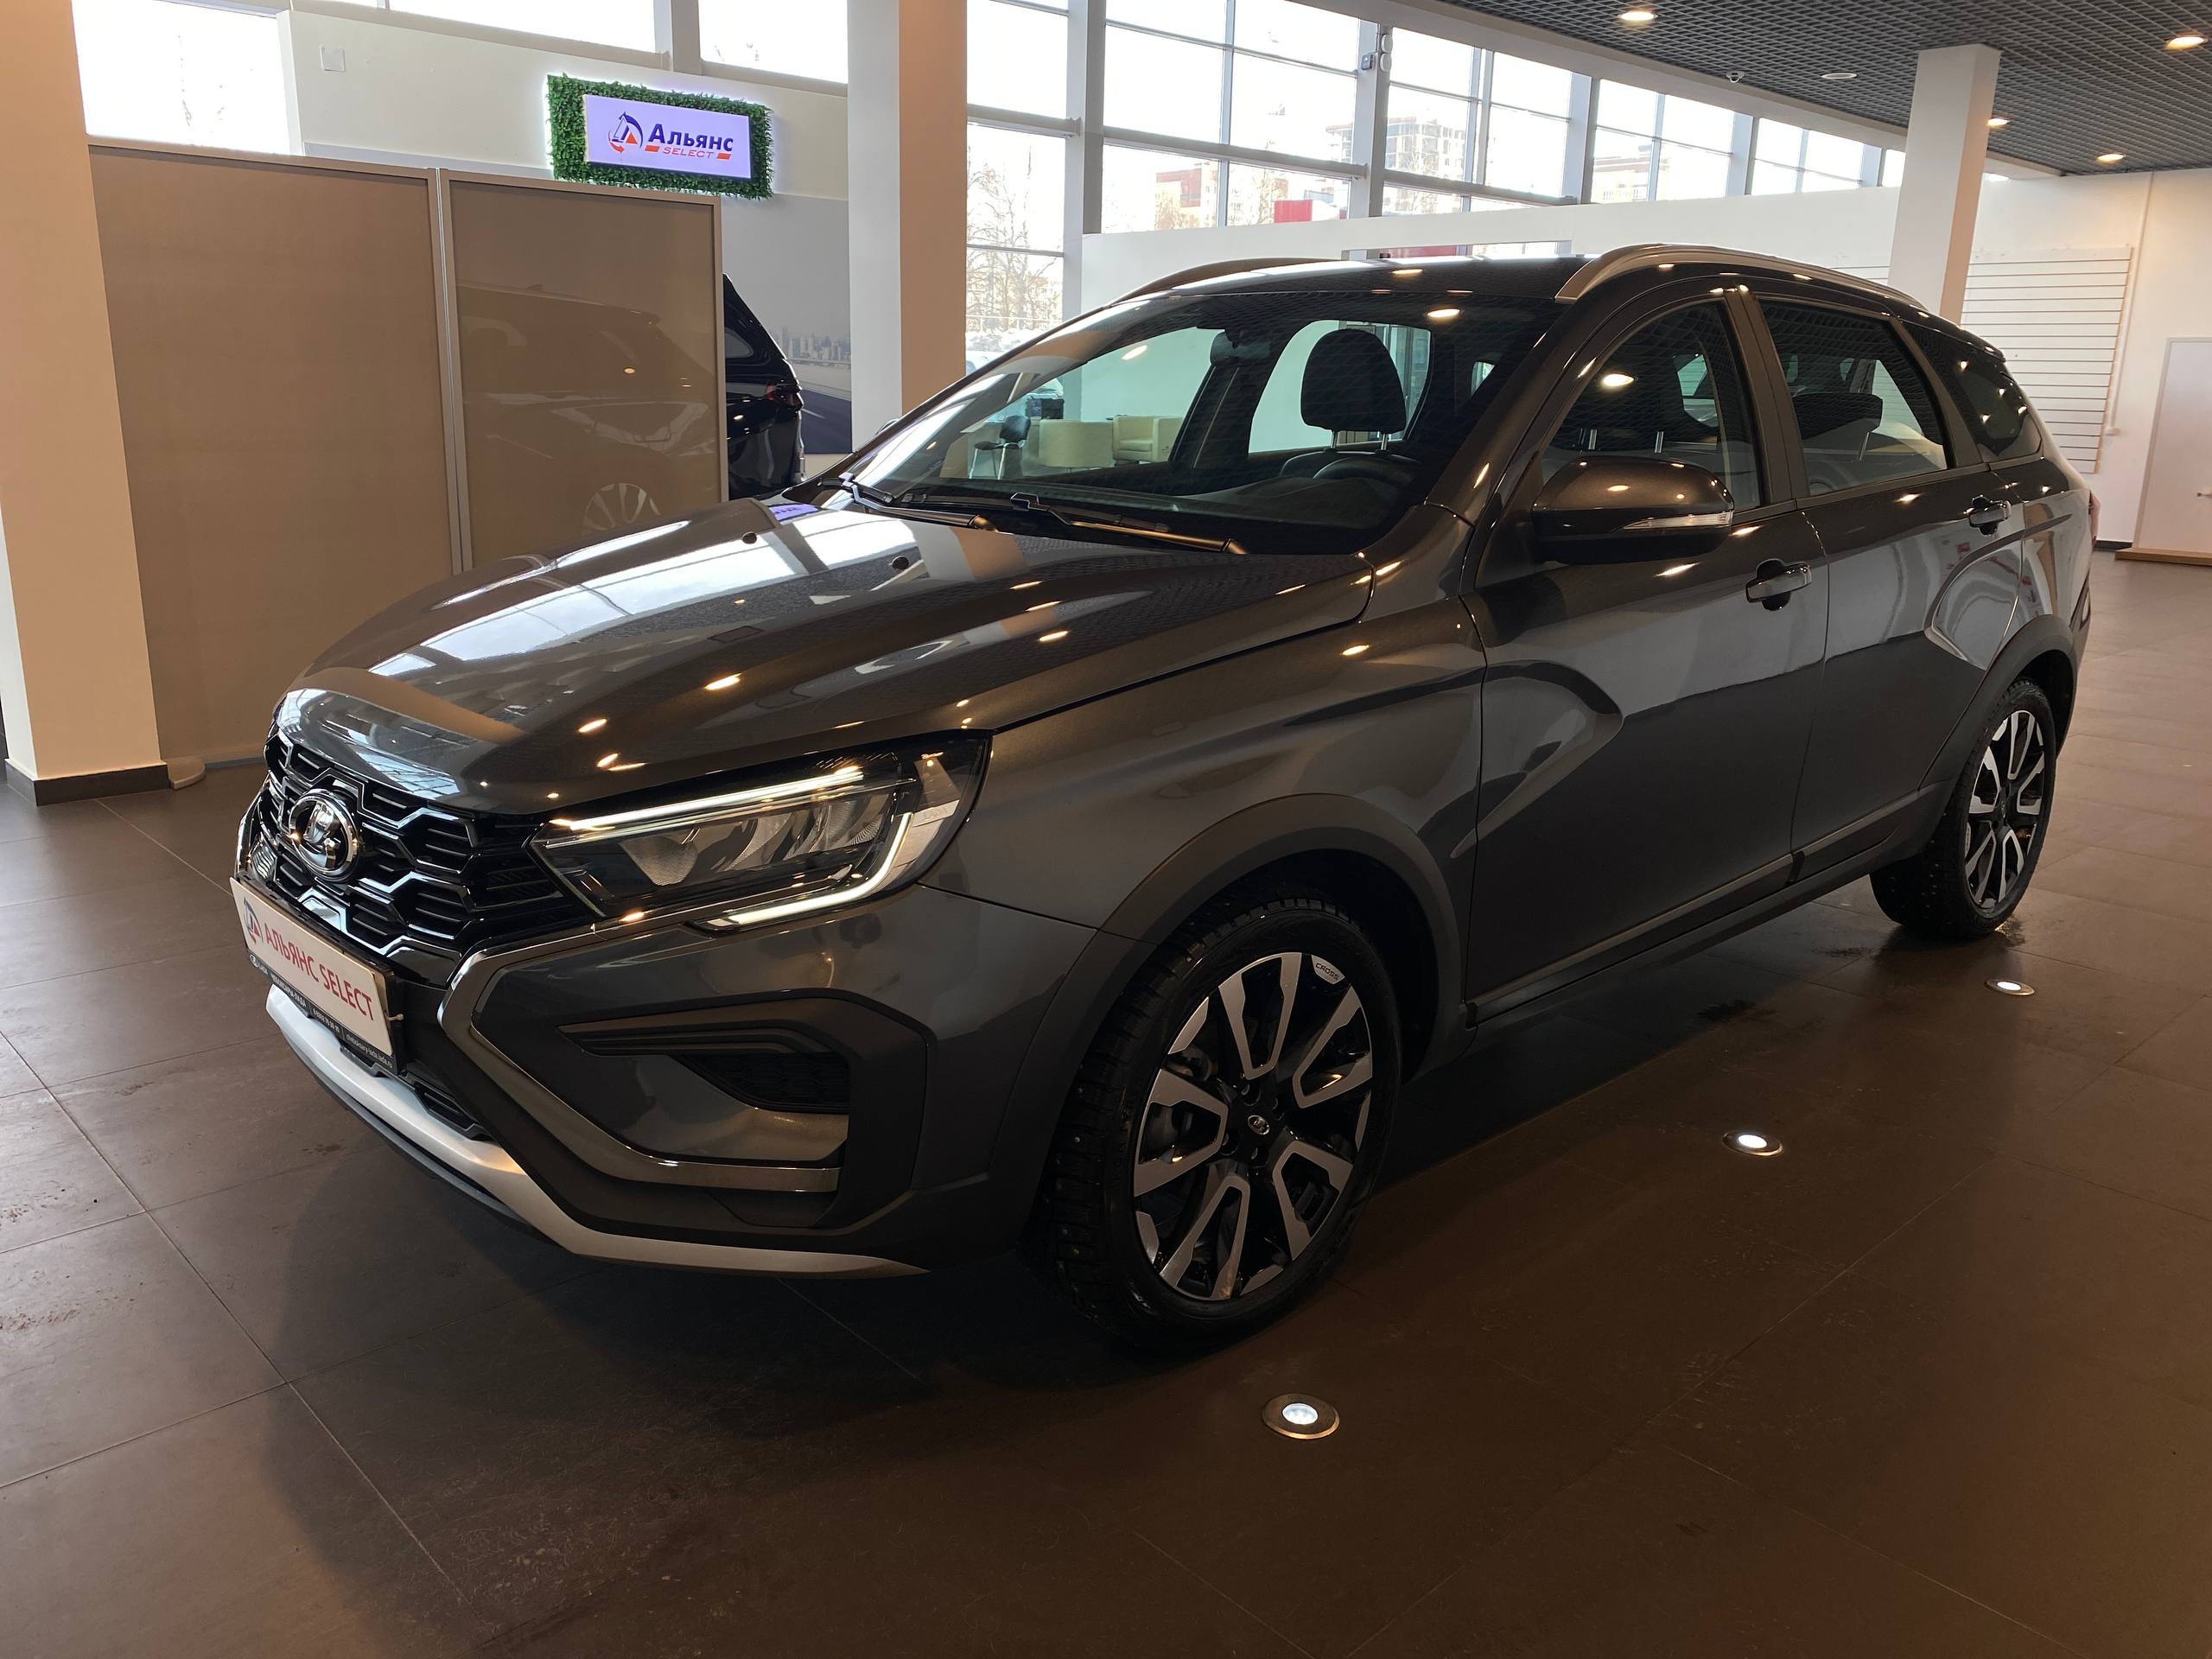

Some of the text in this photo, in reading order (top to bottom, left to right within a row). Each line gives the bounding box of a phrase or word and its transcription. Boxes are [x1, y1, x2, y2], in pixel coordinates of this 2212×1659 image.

[648, 123, 734, 152] Альянс
[663, 146, 714, 159] SELECT
[264, 923, 320, 982] АЛЬЯНС
[319, 963, 374, 1021] SELECT
[1315, 963, 1339, 981] CROSS
